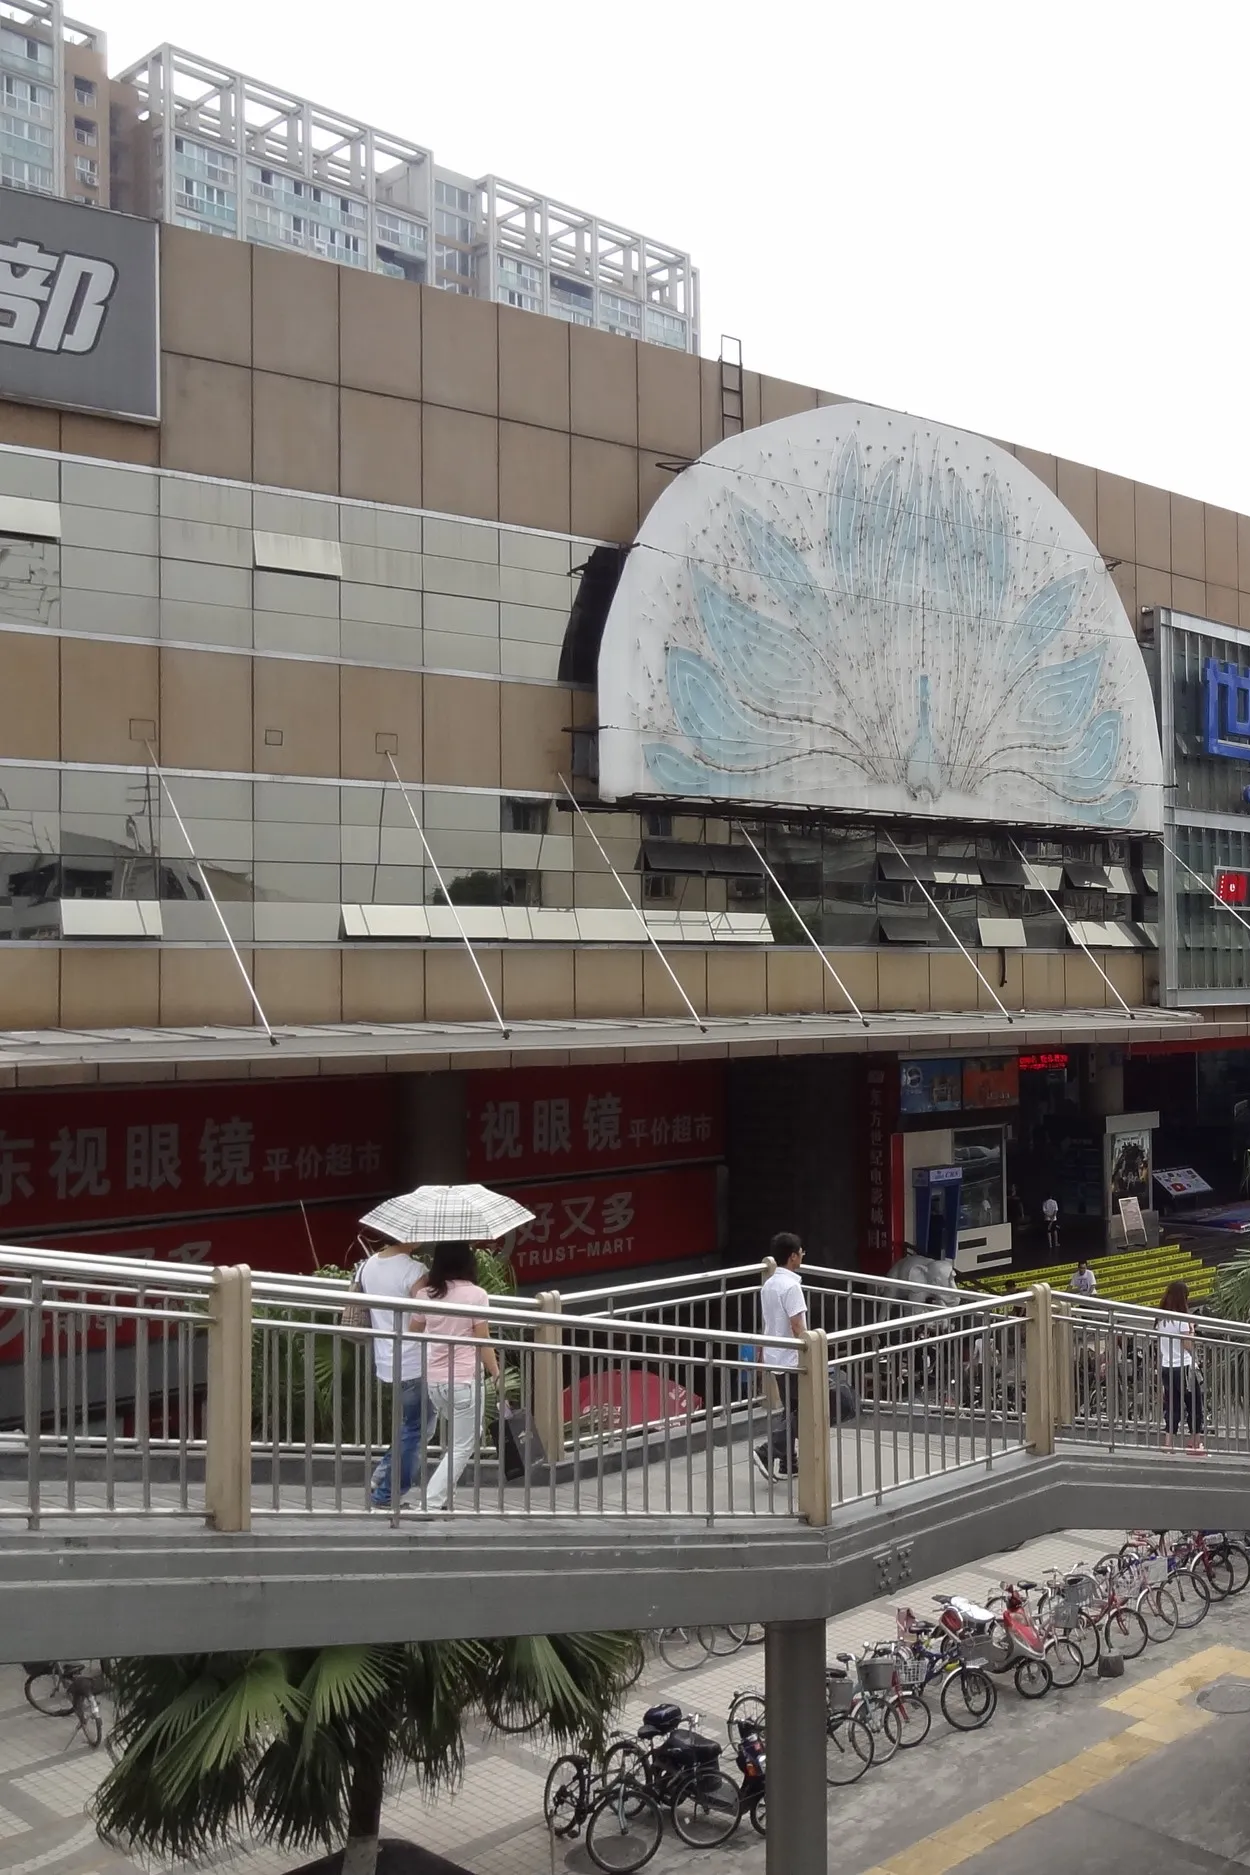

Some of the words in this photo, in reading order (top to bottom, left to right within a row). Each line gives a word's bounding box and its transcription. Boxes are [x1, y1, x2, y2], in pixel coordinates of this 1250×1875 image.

[467, 1091, 625, 1161] 视眼镜
[627, 1115, 713, 1148] 平价超市
[262, 1143, 383, 1182] 平价超市
[517, 1191, 635, 1246] 好又多
[516, 1236, 636, 1268] TRUST-MART
